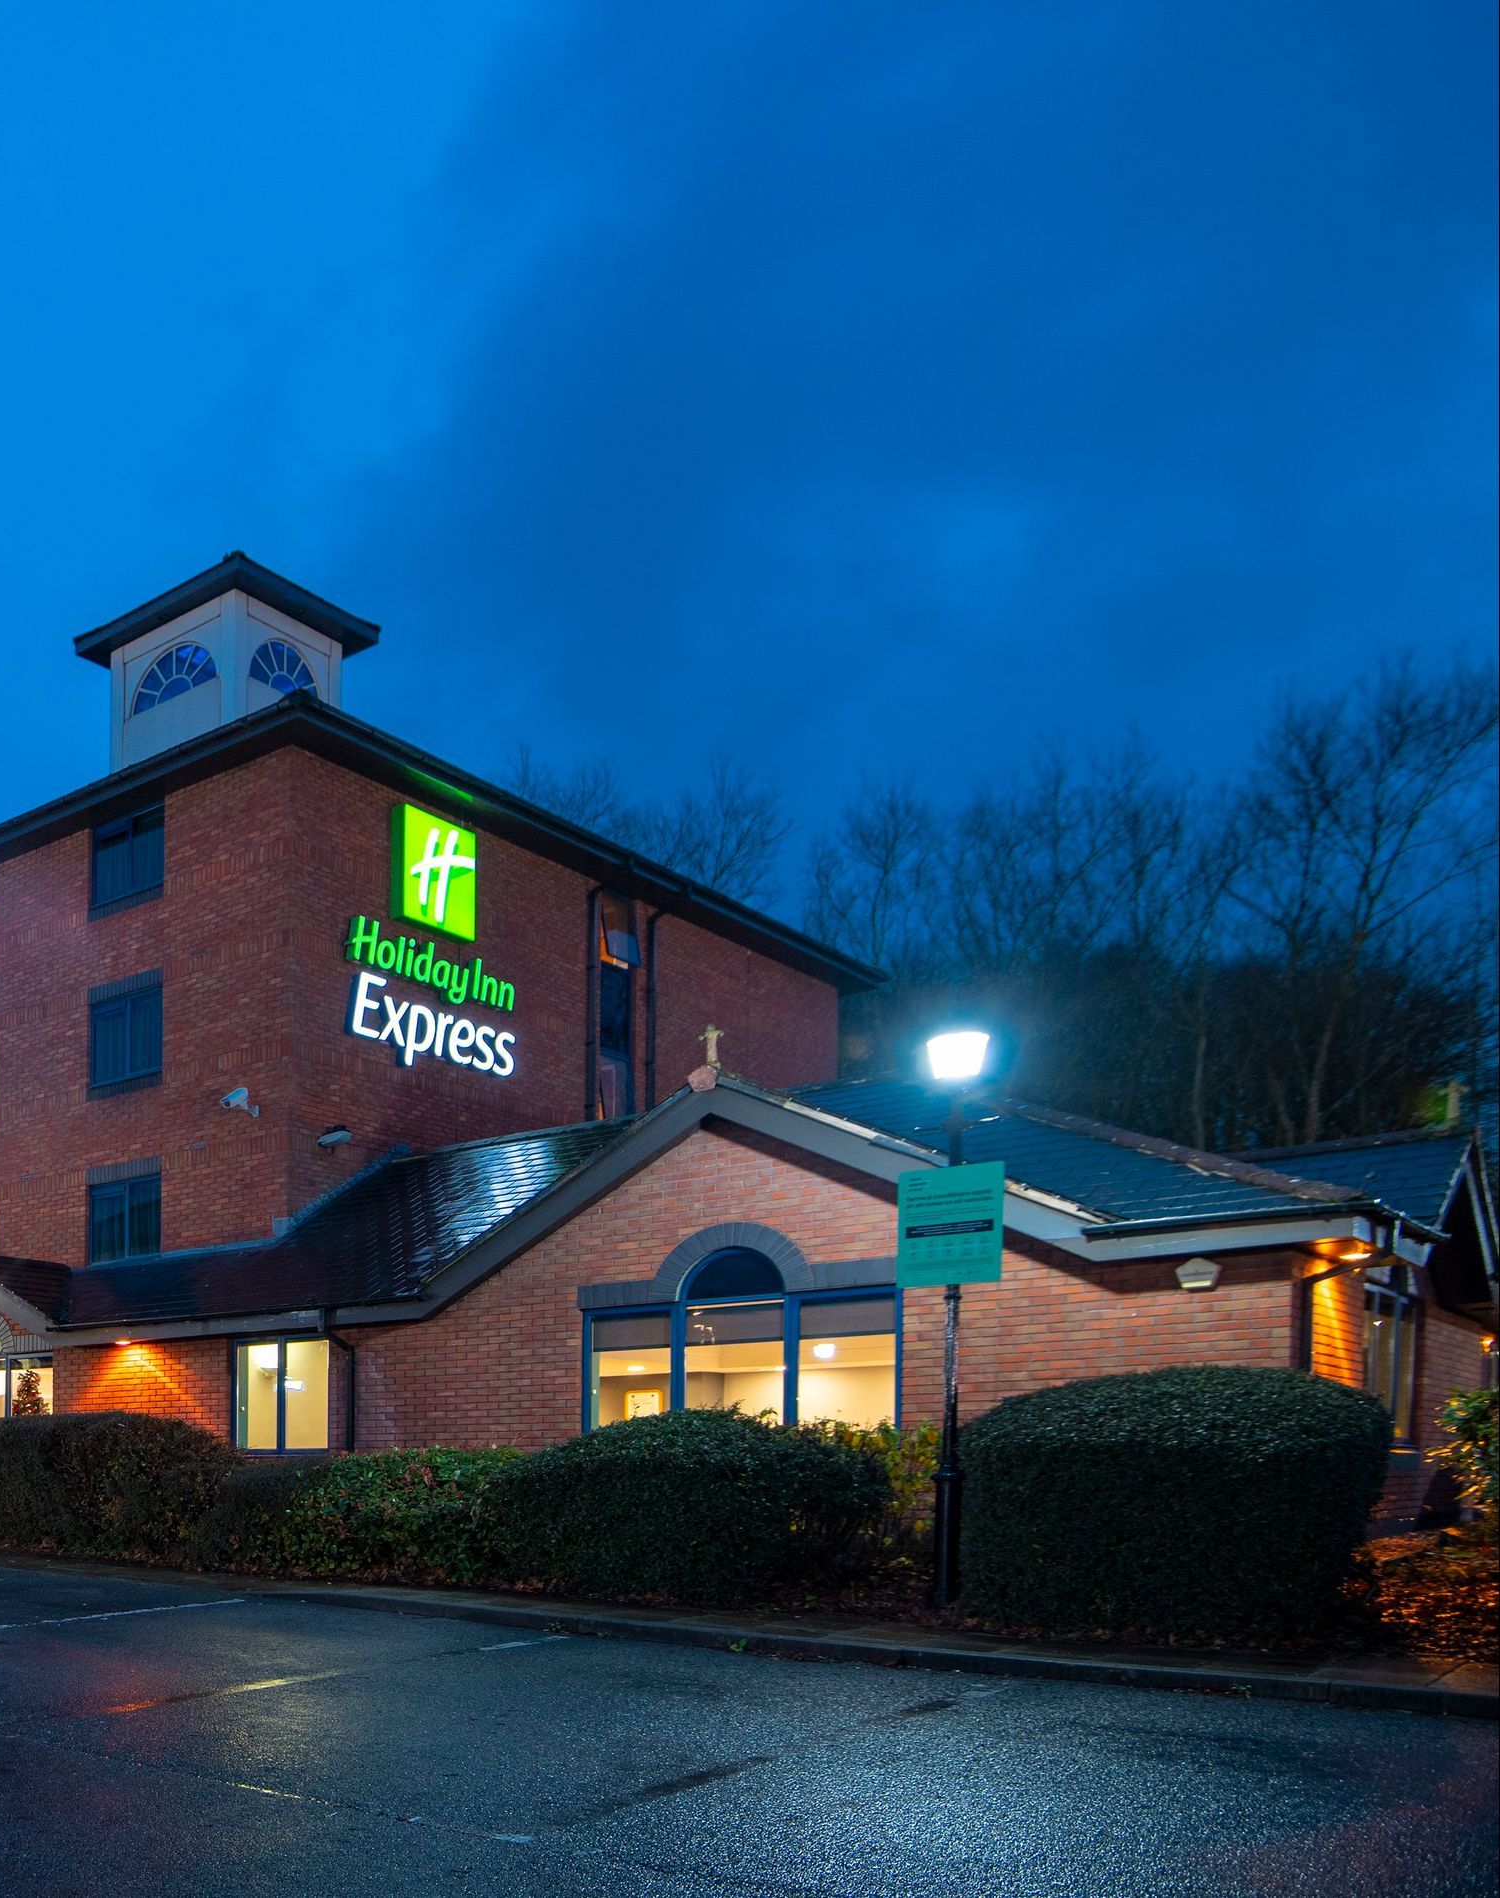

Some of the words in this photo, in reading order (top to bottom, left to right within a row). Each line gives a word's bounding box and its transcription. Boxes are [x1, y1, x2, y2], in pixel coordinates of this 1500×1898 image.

[349, 915, 470, 1004] Holiday
[472, 957, 515, 1011] Inn
[352, 971, 516, 1077] Express
